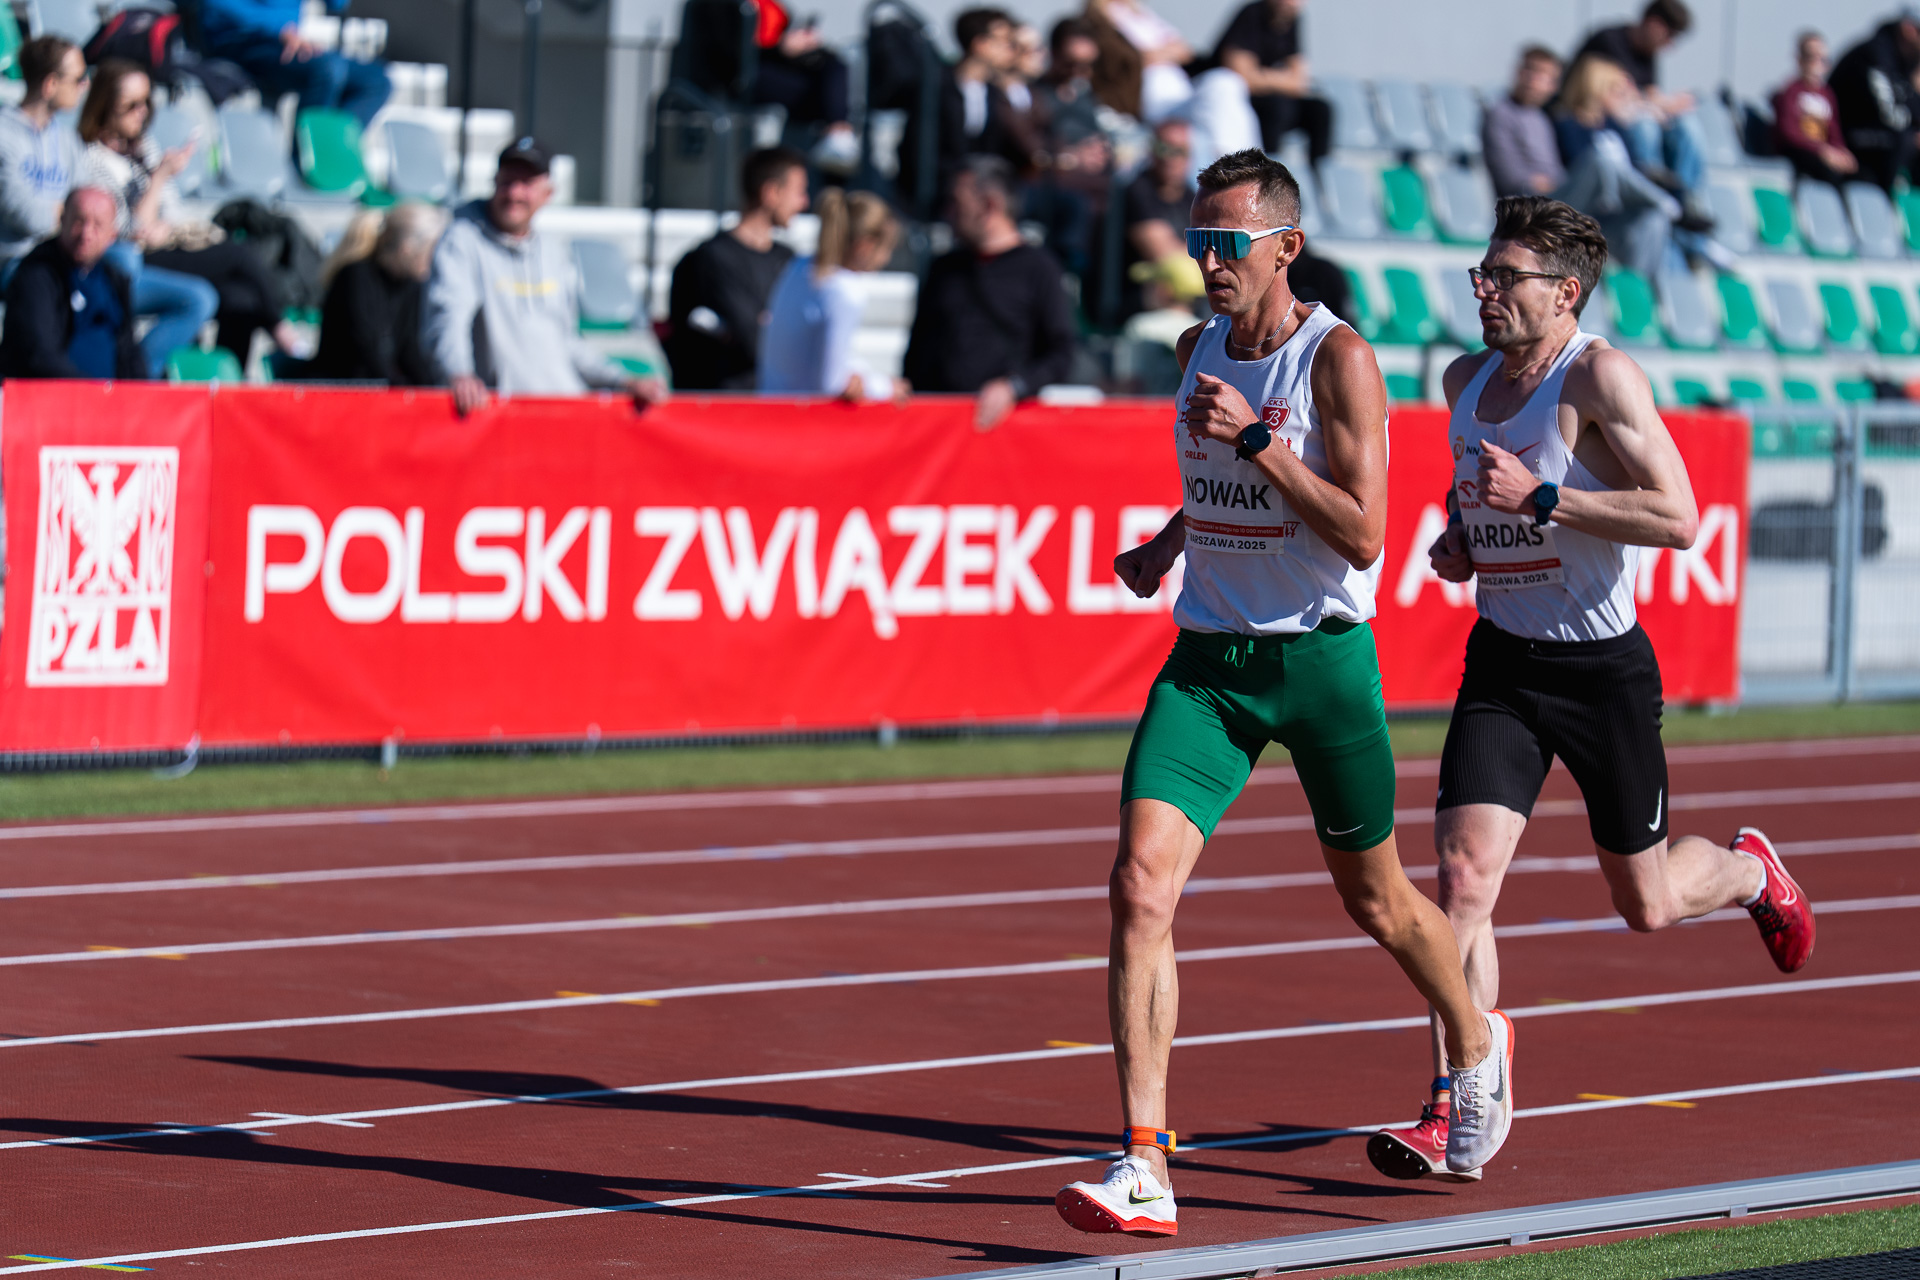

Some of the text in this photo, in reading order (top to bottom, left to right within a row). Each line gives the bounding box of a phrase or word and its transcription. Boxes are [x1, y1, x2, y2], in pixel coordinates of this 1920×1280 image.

[1268, 399, 1283, 407] CKS
[1264, 408, 1282, 427] B
[1185, 450, 1207, 460] ORLEN
[1466, 445, 1480, 455] NN
[1185, 474, 1271, 510] NOWAK
[1237, 541, 1266, 550] 2025
[245, 505, 611, 622] POLSKI
[633, 504, 1058, 640] ZWIĄZEK
[1522, 572, 1549, 584] 2025
[39, 607, 161, 668] PZLA
